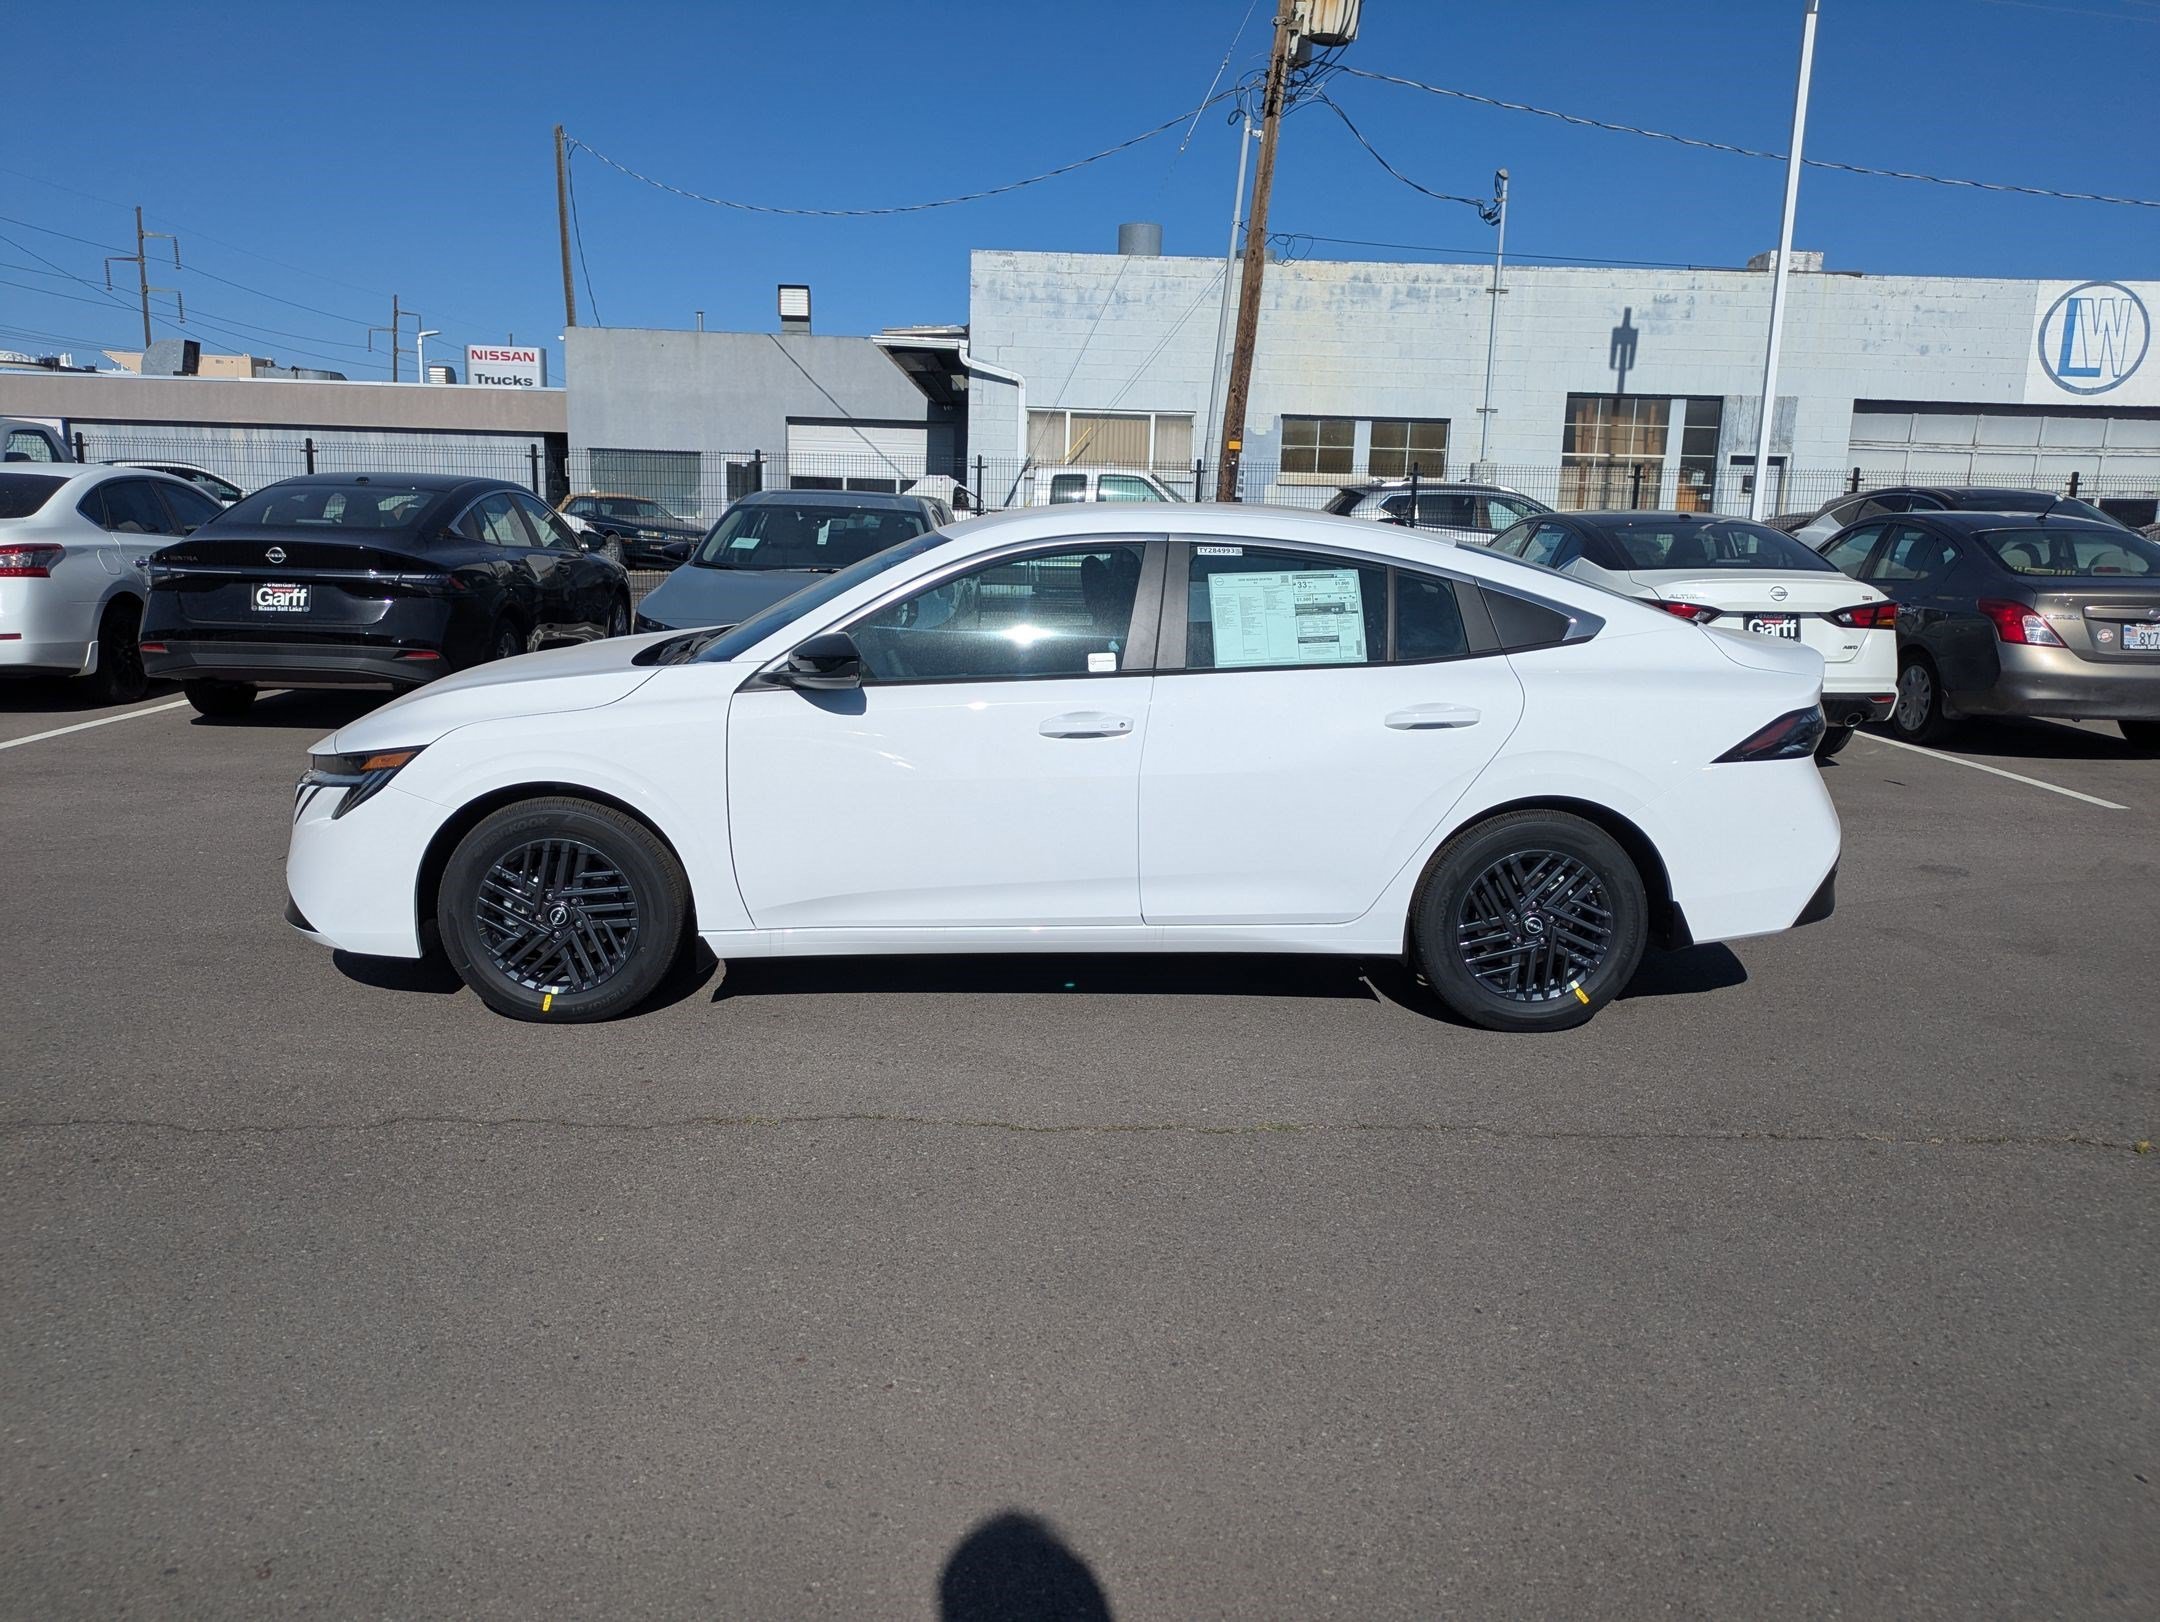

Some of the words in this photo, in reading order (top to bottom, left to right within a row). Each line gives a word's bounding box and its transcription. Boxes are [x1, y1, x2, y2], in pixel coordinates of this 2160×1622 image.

[2057, 297, 2132, 378] LW
[471, 350, 535, 362] NISSAN
[474, 373, 533, 386] Trucks
[1297, 581, 1307, 589] 33
[256, 587, 308, 606] Garff
[1748, 618, 1797, 637] Garff
